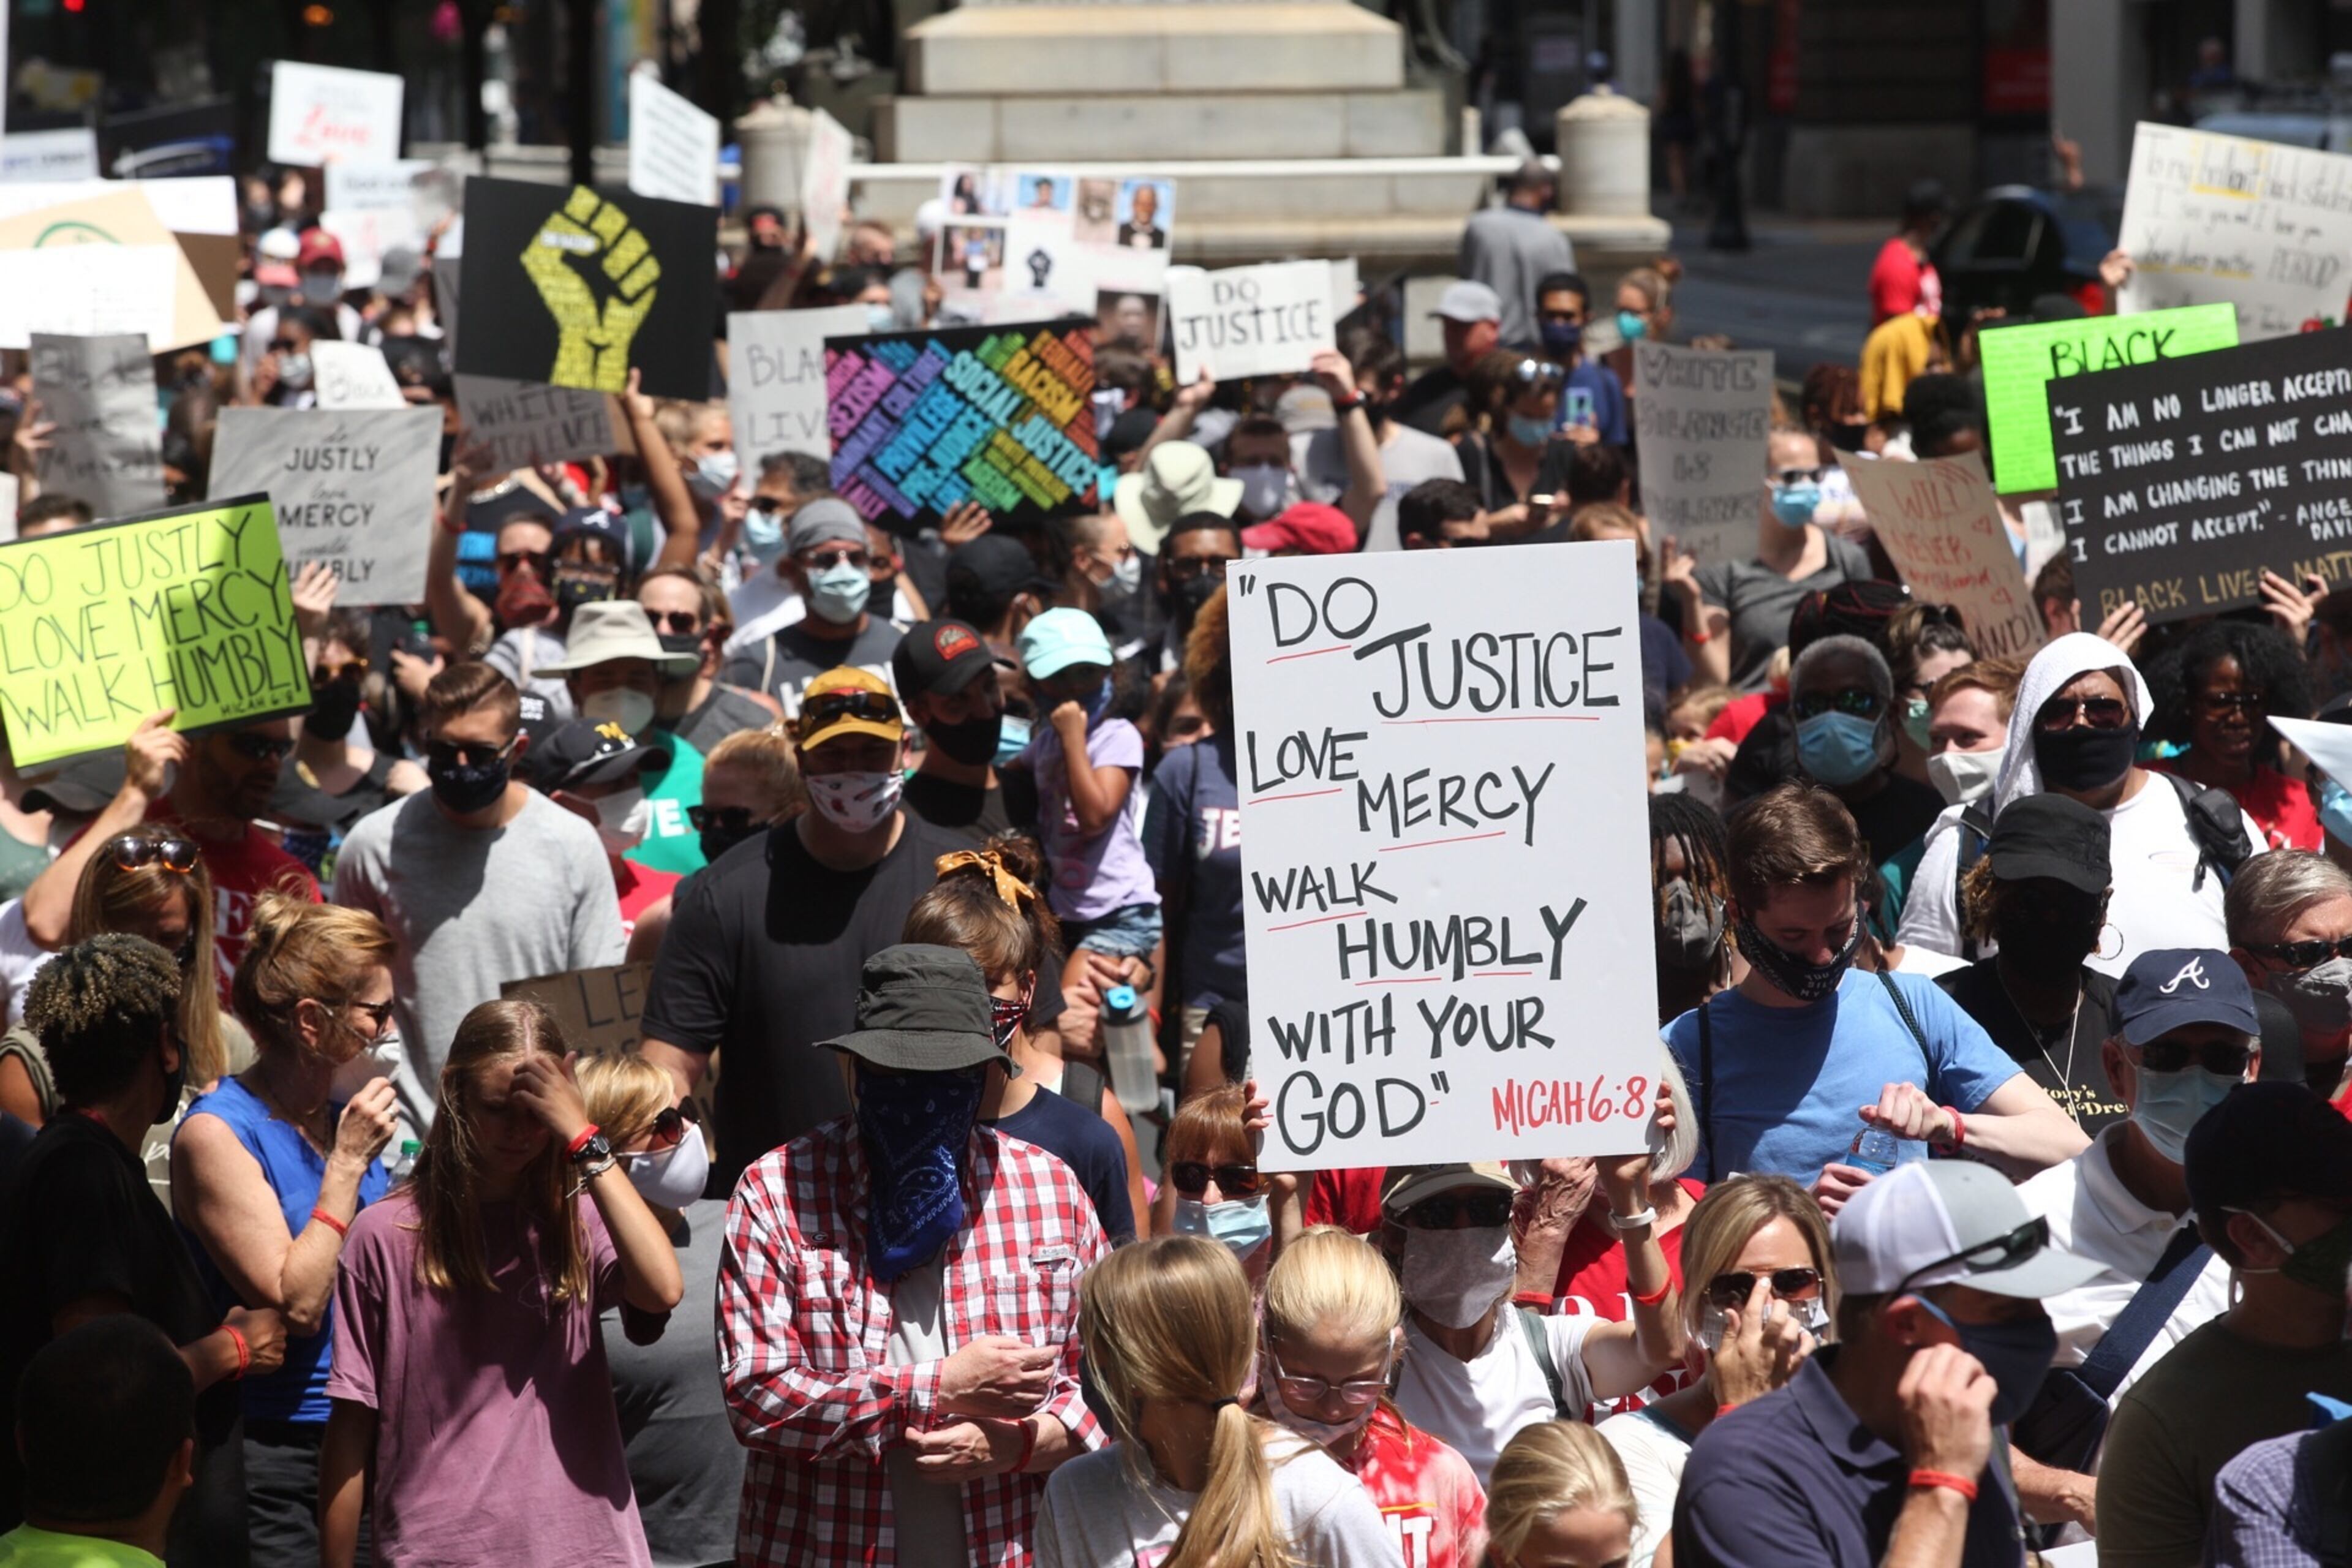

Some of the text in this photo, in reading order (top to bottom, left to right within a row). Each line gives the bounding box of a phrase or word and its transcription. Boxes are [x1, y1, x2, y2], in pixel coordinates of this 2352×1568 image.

[1213, 278, 1261, 304] DO
[1180, 300, 1322, 350] JUSTICE
[2049, 328, 2178, 377] BLACK
[1003, 348, 1084, 428] RACISM
[1638, 347, 1757, 392] WHITE
[323, 423, 349, 443] do
[875, 387, 967, 482] PRIVILEGE
[943, 349, 1022, 428] SOCIAL
[1011, 413, 1100, 496] JUSTICE
[2054, 404, 2084, 435] "I
[2107, 401, 2141, 432] AM
[2153, 394, 2182, 423] NO
[2201, 380, 2275, 413] LONGER
[284, 447, 380, 472] JUSTLY
[899, 405, 996, 508] PREJUDICE
[1673, 450, 1713, 483] IS
[2060, 450, 2101, 479] THE
[2108, 439, 2174, 470] THINGS
[2187, 434, 2203, 457] I
[2220, 426, 2256, 452] CAN
[2267, 418, 2301, 447] NOT
[278, 502, 375, 529] MERCY
[2065, 499, 2084, 525] I
[2103, 491, 2138, 519] AM
[2147, 472, 2241, 509] CHANGING
[2248, 466, 2289, 491] THE
[80, 511, 252, 597] JUSTLY
[287, 560, 375, 582] UBLY
[2070, 536, 2088, 563] I
[2104, 522, 2179, 554] CANNOT
[0, 558, 285, 675] LOVE MERCY
[1973, 603, 2044, 660] AND!
[0, 614, 303, 738] WALK HUMBLY
[1354, 622, 1623, 718] JUSTICE
[221, 695, 266, 715] MICAH
[1247, 726, 1368, 793] LOVE
[1358, 763, 1556, 846] MERCY
[1251, 861, 1398, 913] WALK
[1336, 897, 1588, 982] HUMBLY
[578, 966, 653, 1028] LE
[1268, 992, 1556, 1065] WITH YOUR
[1276, 1070, 1648, 1156] GOD" MICAH 6:8
[2076, 1101, 2130, 1116] Dre
